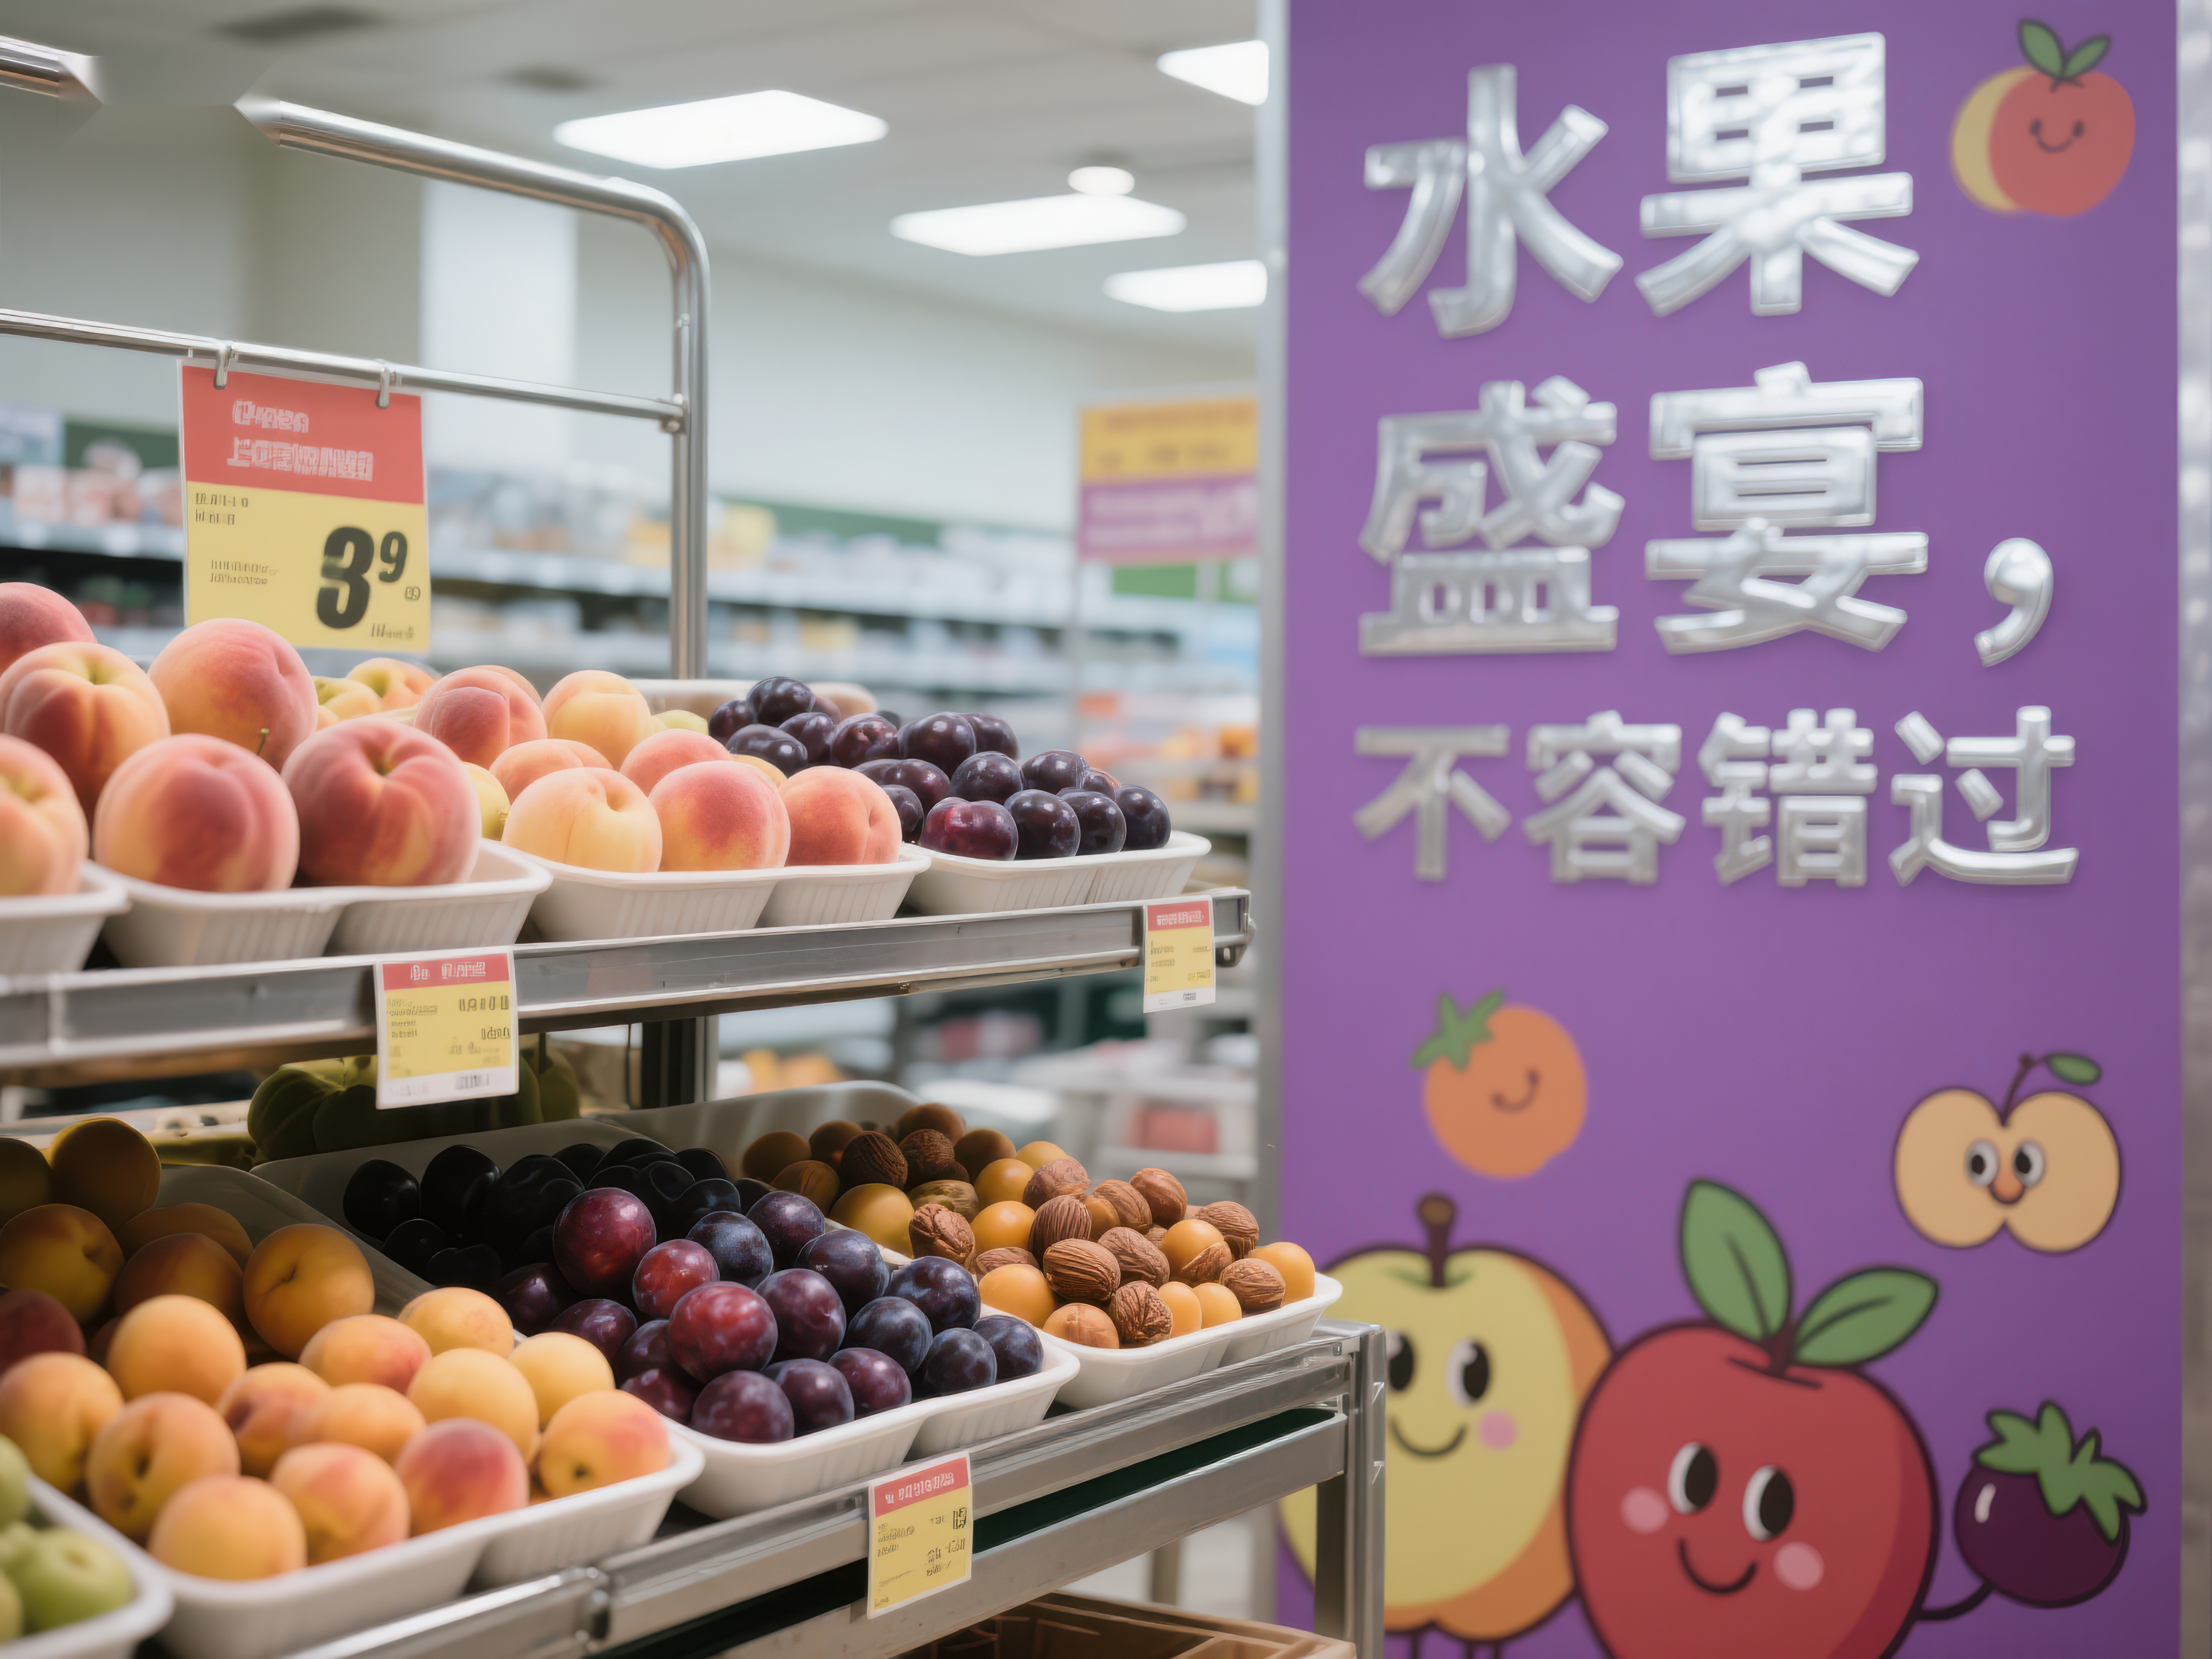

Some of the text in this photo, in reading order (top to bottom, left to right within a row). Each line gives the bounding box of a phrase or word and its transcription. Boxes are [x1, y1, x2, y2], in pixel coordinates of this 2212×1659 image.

[1357, 32, 1920, 339] 水果
[1353, 706, 2080, 888] 不容错过
